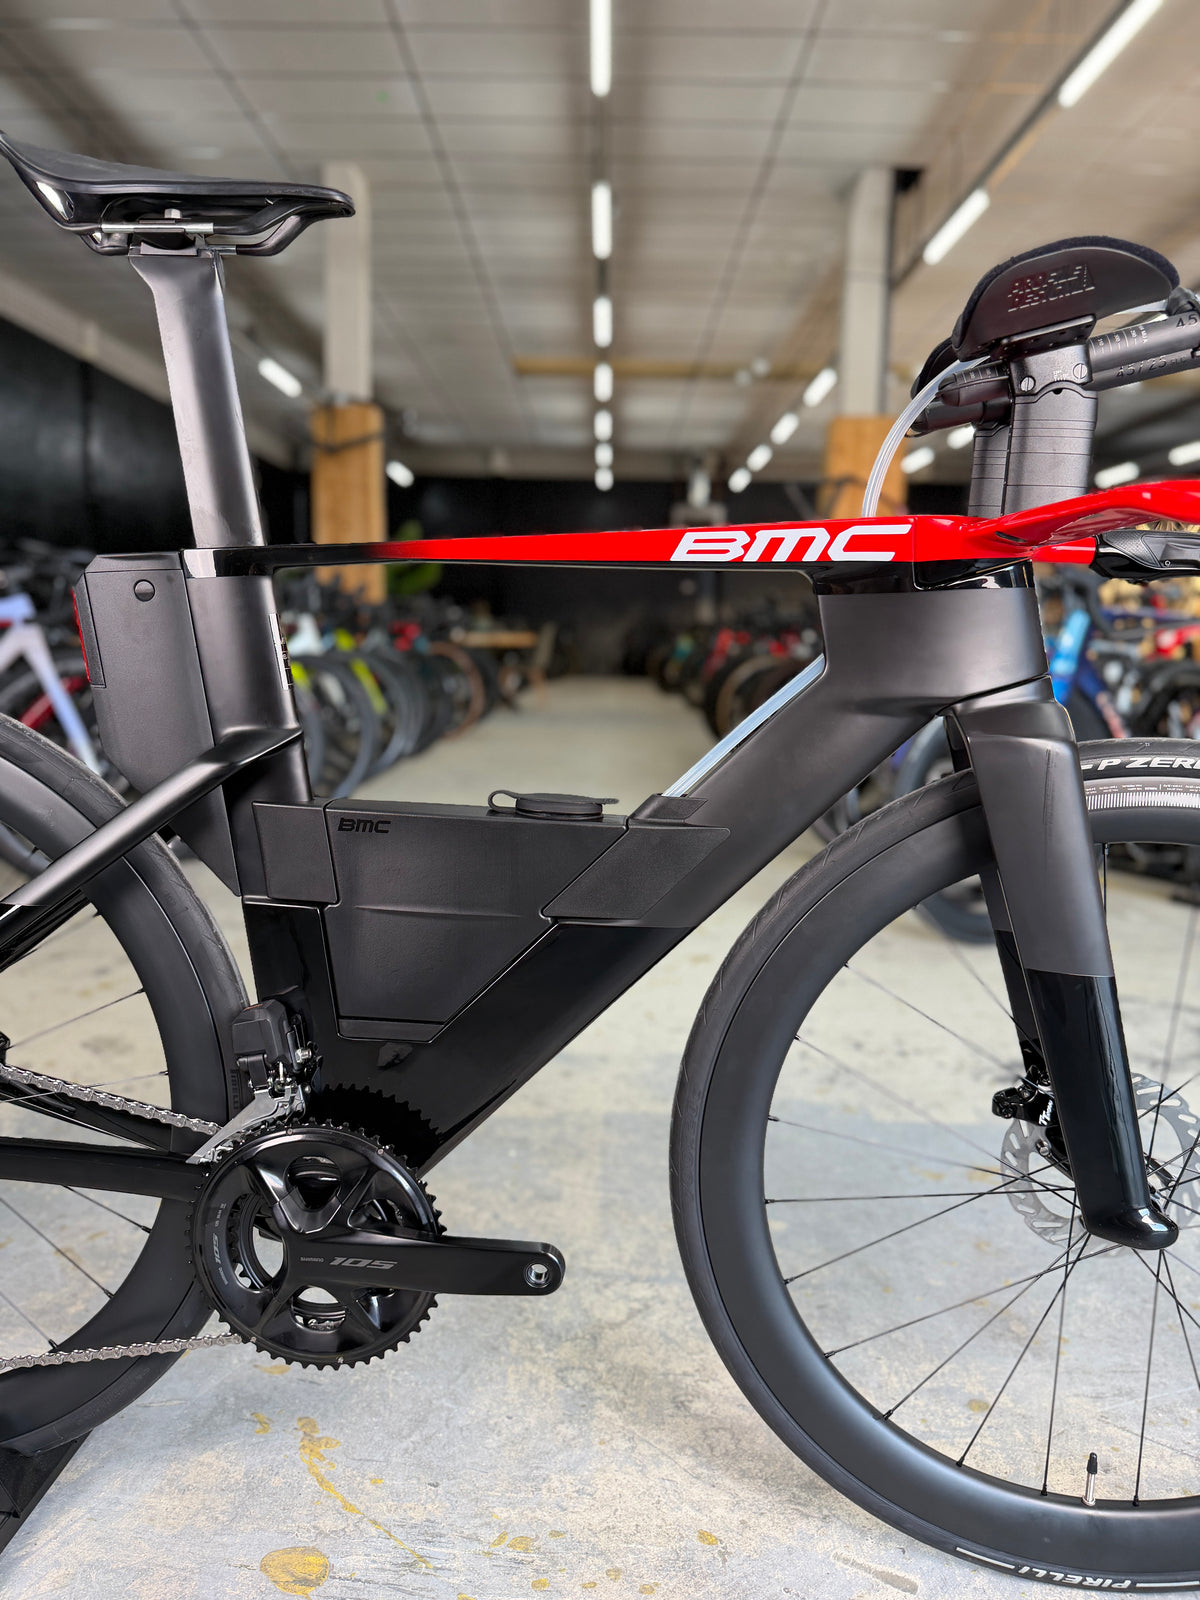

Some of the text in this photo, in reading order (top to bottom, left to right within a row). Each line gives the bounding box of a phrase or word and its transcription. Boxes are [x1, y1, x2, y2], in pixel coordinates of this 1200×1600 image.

[670, 524, 912, 561] BMC
[1097, 759, 1121, 771] P
[338, 817, 391, 833] BMC
[329, 1256, 398, 1270] 105
[1019, 1566, 1132, 1589] PIRELLI
